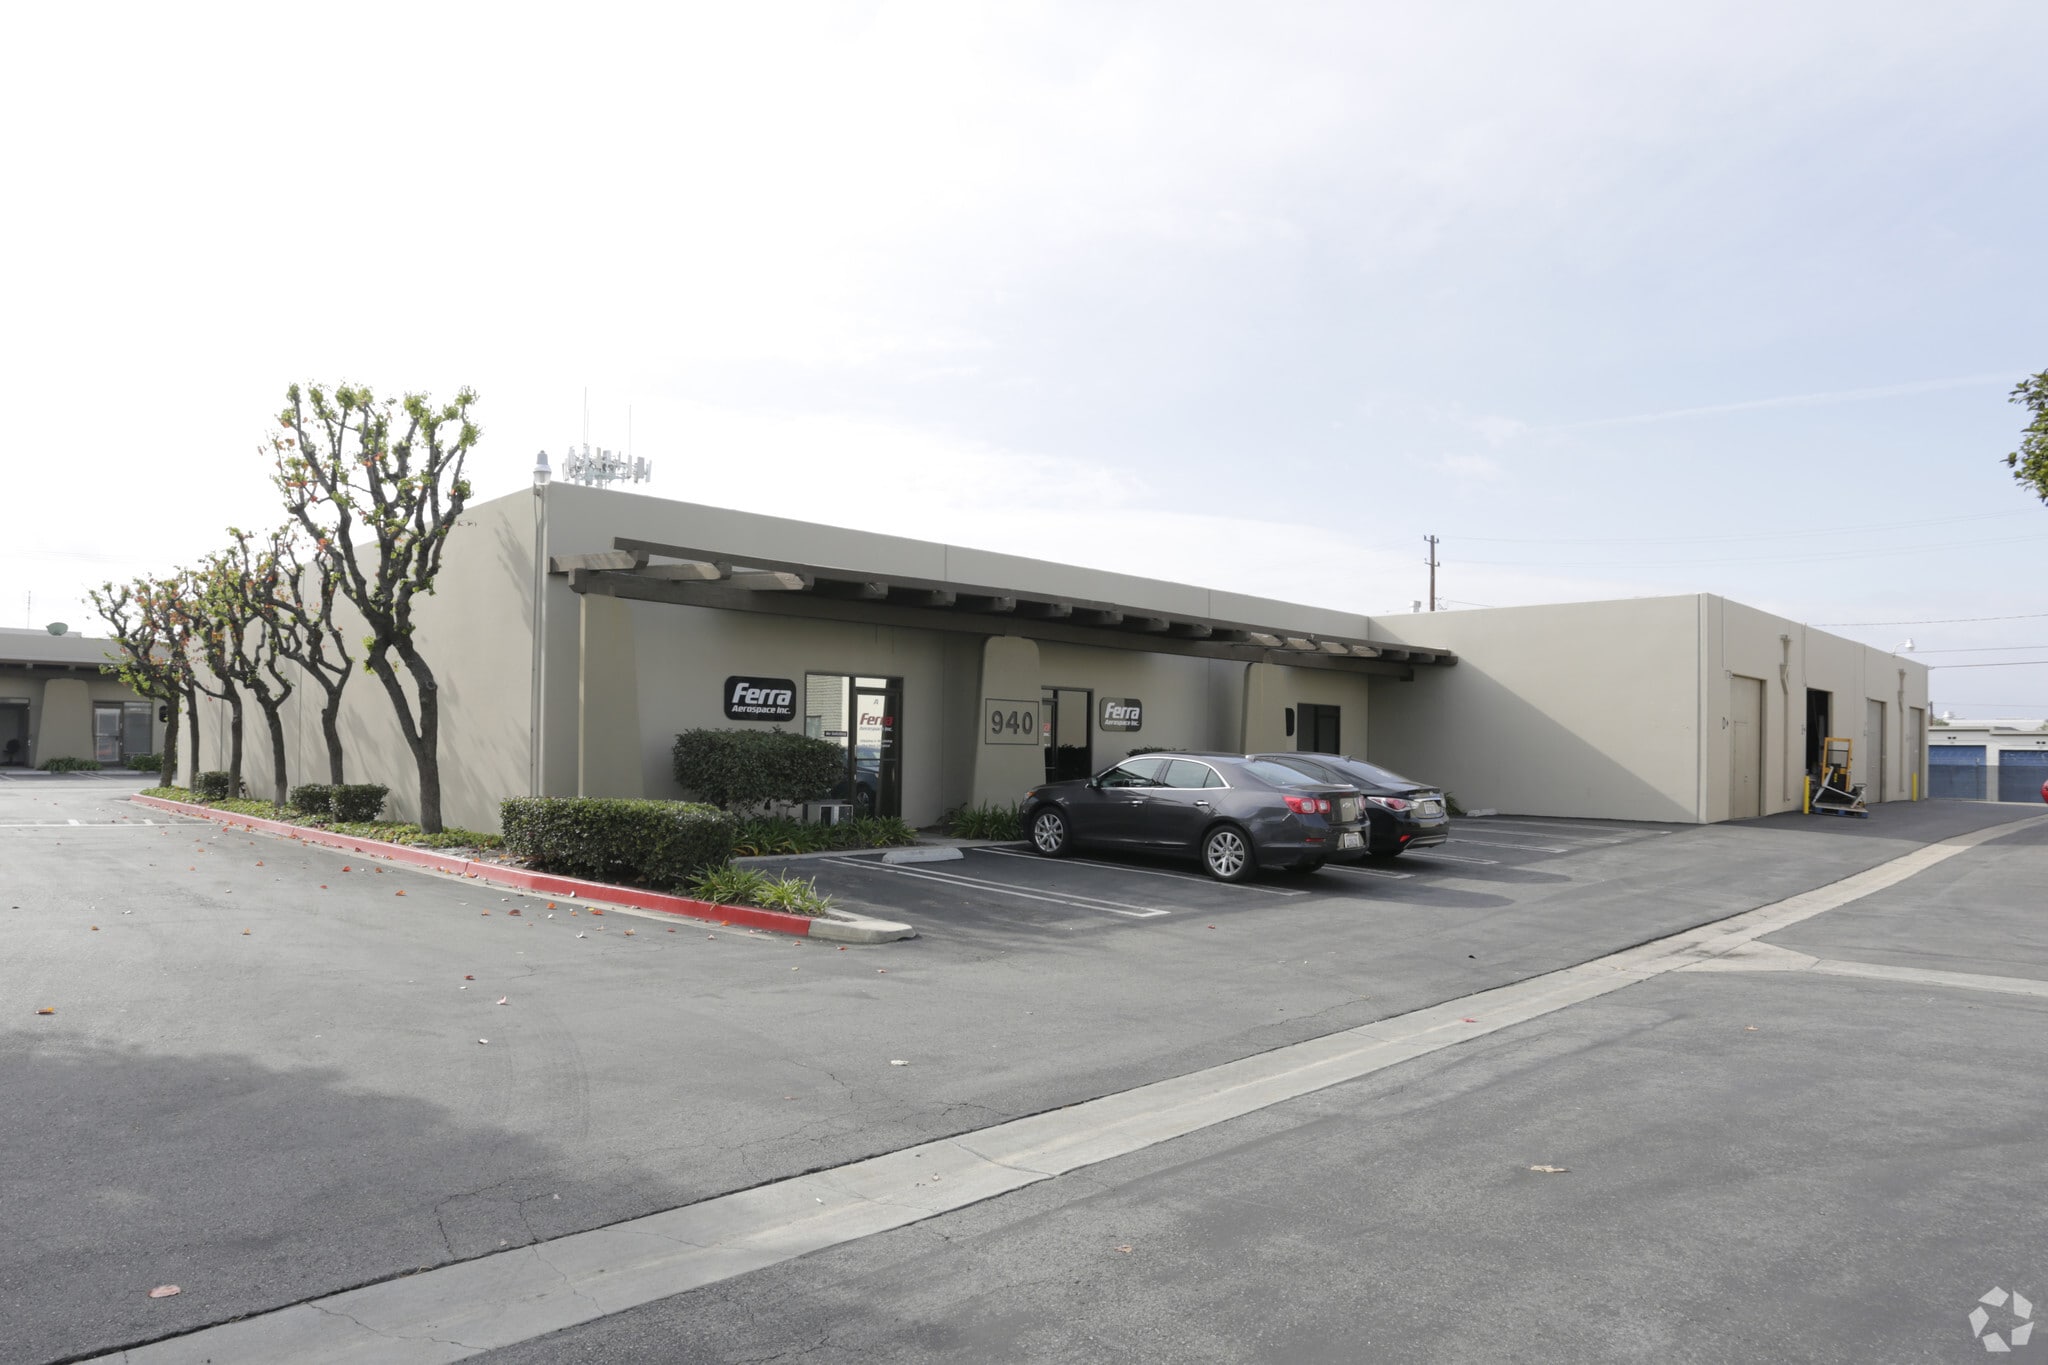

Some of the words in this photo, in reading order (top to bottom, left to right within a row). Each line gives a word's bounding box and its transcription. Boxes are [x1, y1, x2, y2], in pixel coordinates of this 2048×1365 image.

[732, 682, 792, 706] Ferra
[731, 704, 776, 714] Aerospace
[776, 706, 791, 714] Inc.
[1104, 702, 1140, 720] Ferra
[860, 712, 894, 727] Ferra
[991, 710, 1033, 735] 940
